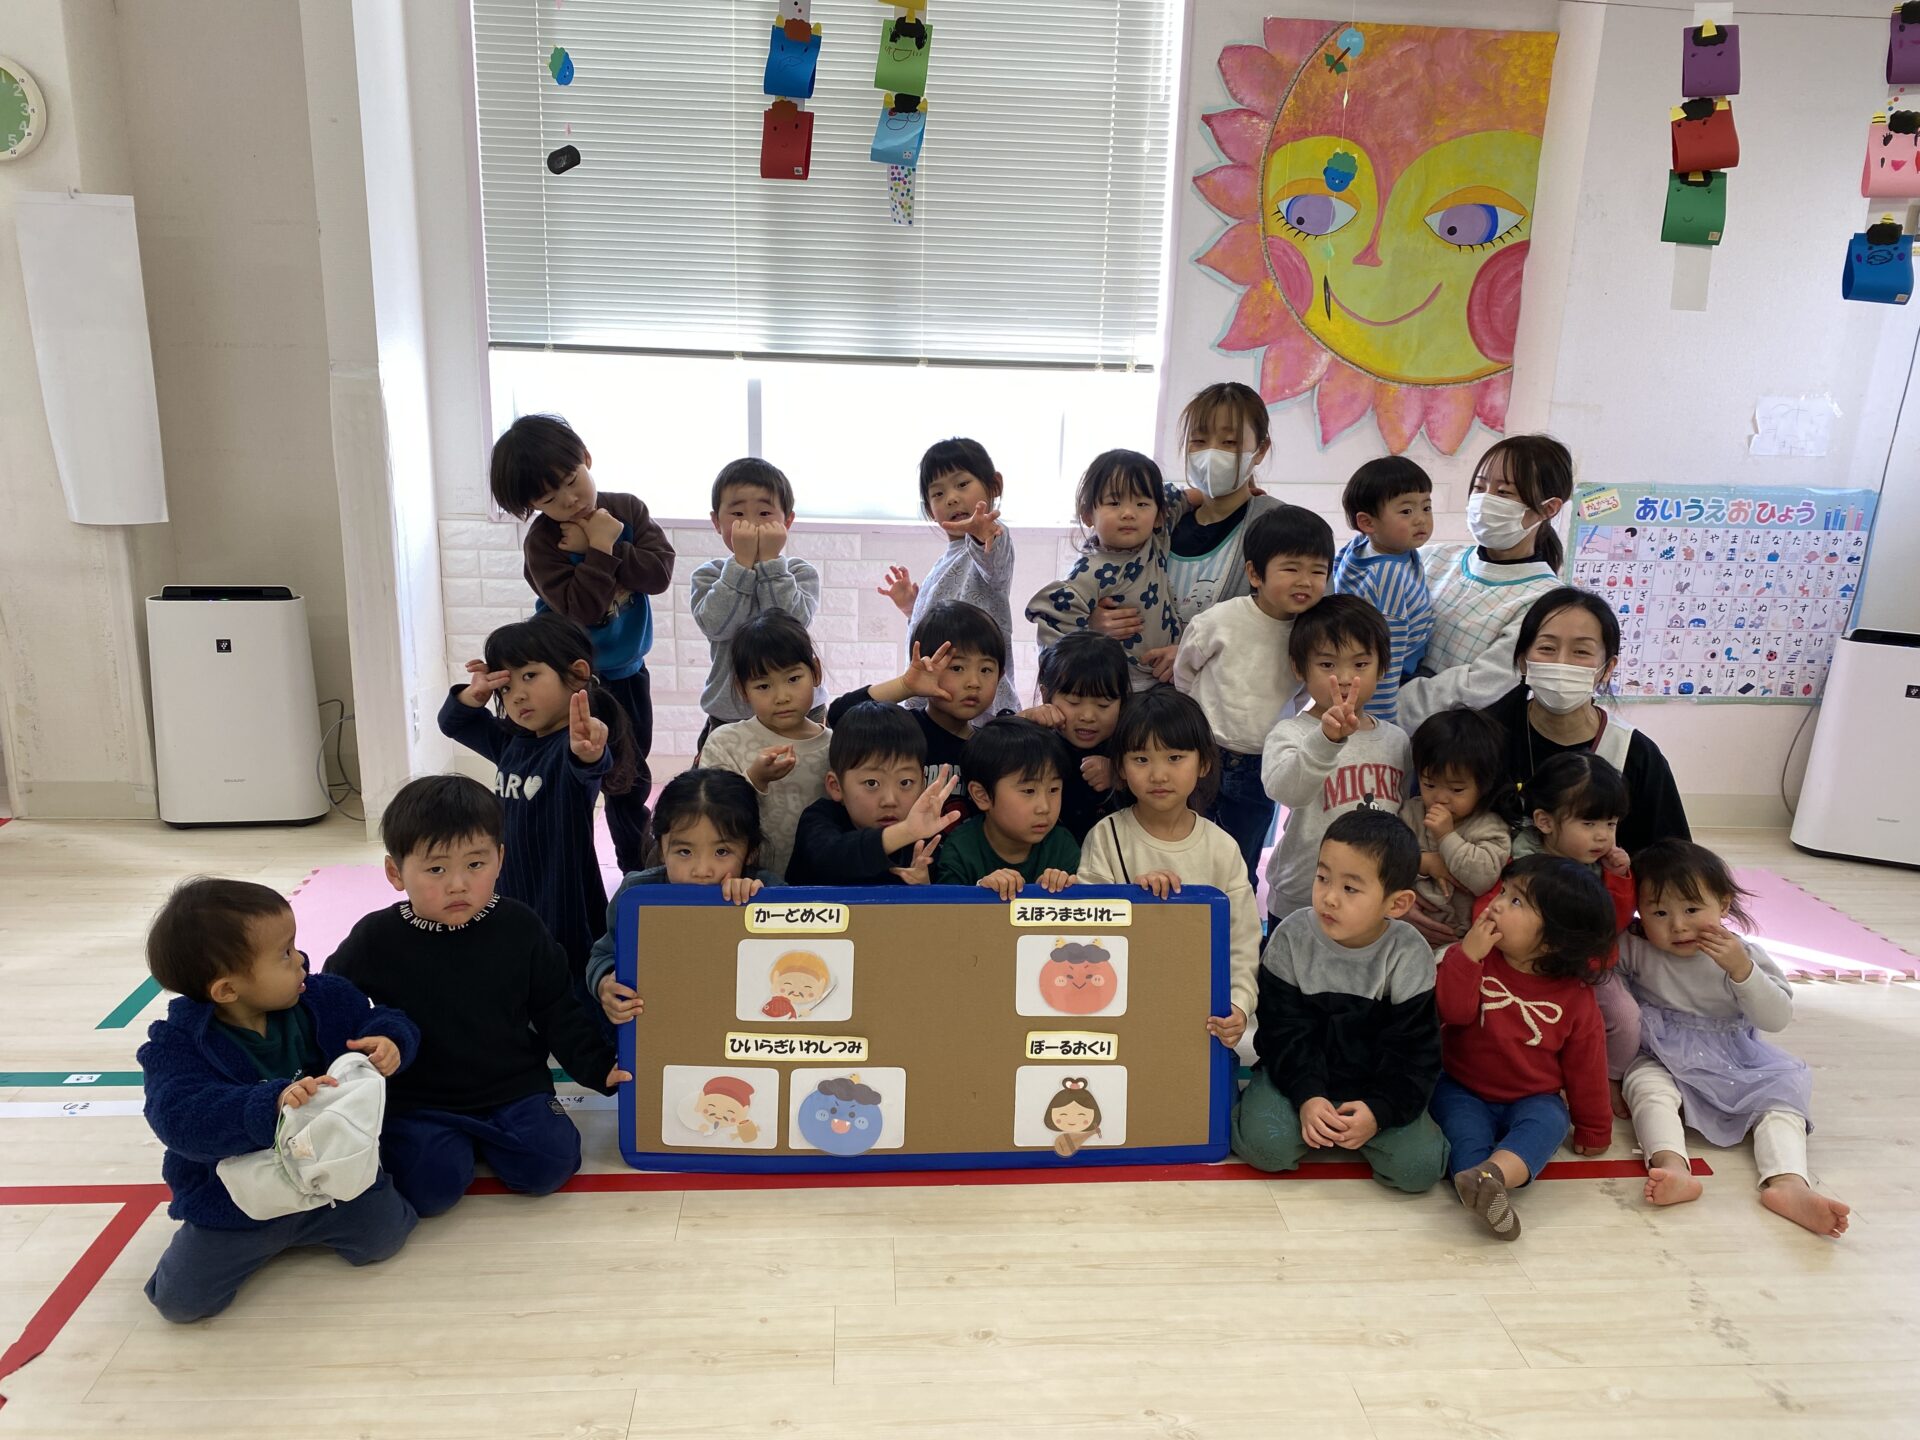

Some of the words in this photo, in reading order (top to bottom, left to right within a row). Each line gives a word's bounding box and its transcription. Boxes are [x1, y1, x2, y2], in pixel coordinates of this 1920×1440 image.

[13, 84, 23, 96] 2
[20, 103, 29, 116] 3
[8, 134, 17, 146] 5
[1647, 532, 1656, 541] ん
[1668, 533, 1677, 541] わ
[1690, 533, 1697, 542] ら
[1710, 534, 1719, 543] や
[1731, 534, 1739, 544] ま
[1751, 535, 1760, 544] は
[1772, 535, 1781, 545] な
[1793, 536, 1801, 545] た
[1814, 536, 1821, 545] さ
[1832, 536, 1842, 545] か
[1853, 537, 1863, 546] あ
[1642, 564, 1652, 573] が
[1685, 567, 1691, 576] り
[1723, 569, 1732, 577] み
[1745, 568, 1754, 578] ひ
[1765, 569, 1774, 578] に
[1786, 570, 1794, 579] ち
[1807, 570, 1813, 579] し
[1827, 570, 1834, 580] き
[1678, 602, 1686, 611] る
[1697, 602, 1706, 611] ゆ
[1718, 604, 1727, 612] む
[1738, 604, 1748, 612] ふ
[1758, 604, 1767, 612] ぬ
[1800, 604, 1809, 613] す
[1842, 604, 1849, 614] う
[1670, 636, 1680, 644] れ
[1712, 636, 1721, 644] め
[1752, 636, 1761, 645] ね
[1773, 637, 1781, 645] て
[1793, 638, 1803, 646] せ
[1814, 638, 1823, 647] け
[1648, 668, 1655, 677] を
[1666, 668, 1674, 677] ろ
[1686, 668, 1694, 677] よ
[1707, 668, 1714, 677] も
[1726, 669, 1734, 677] ほ
[1746, 669, 1755, 677] の
[1768, 670, 1776, 679] と
[1787, 670, 1796, 679] そ
[1808, 671, 1815, 679] こ
[399, 903, 414, 920] AND
[410, 917, 443, 932] MOVE
[755, 908, 841, 923] かーどめくり
[1017, 907, 1126, 922] えほうまきりれー
[730, 1039, 862, 1054] ひいらぎいわしつみ
